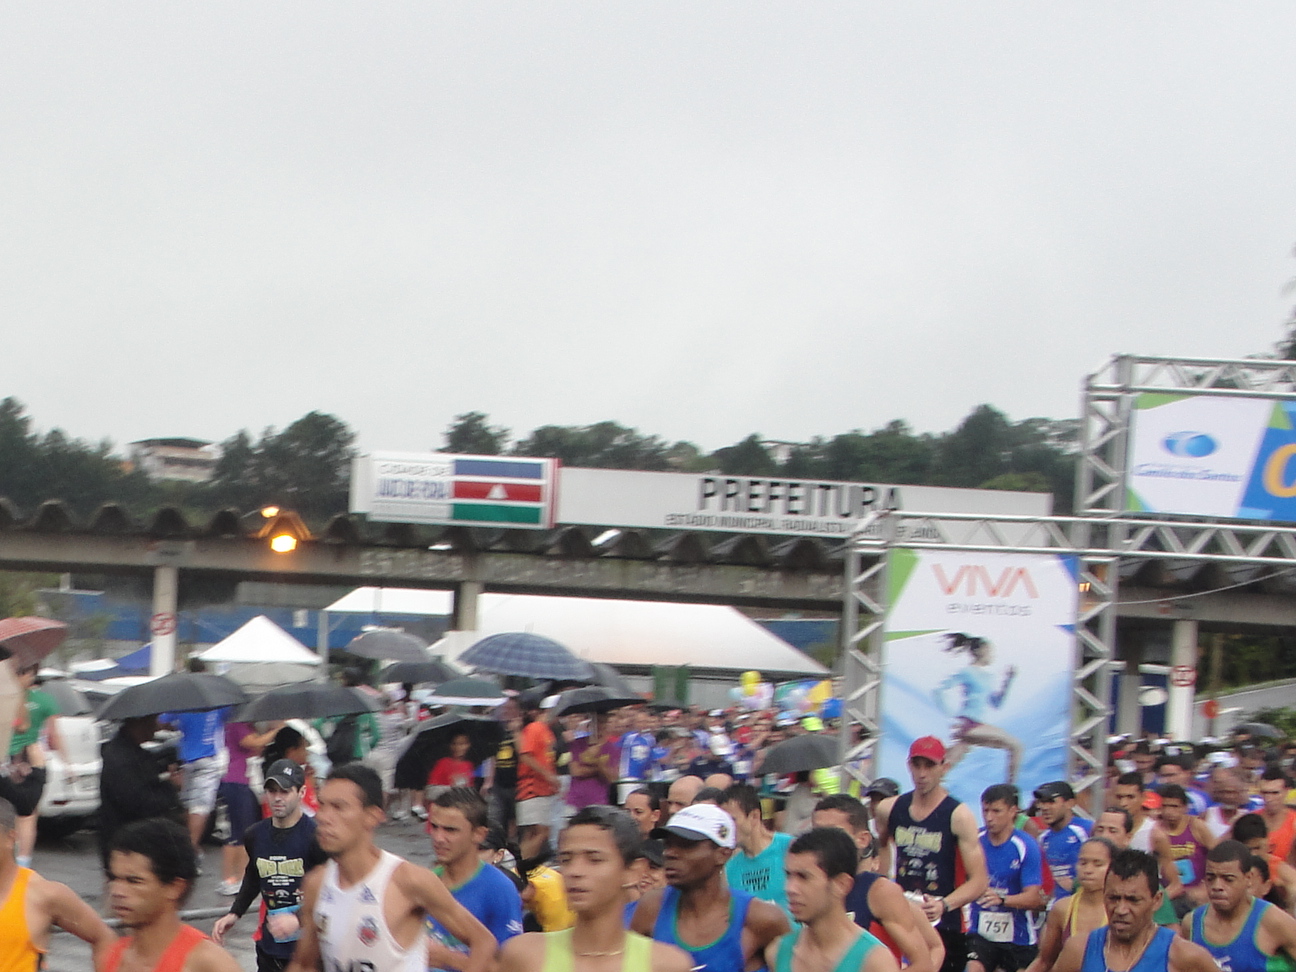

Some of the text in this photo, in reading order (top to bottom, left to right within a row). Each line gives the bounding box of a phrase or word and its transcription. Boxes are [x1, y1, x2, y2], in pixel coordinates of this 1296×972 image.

[699, 477, 903, 519] PREFEITURA
[931, 563, 1040, 599] VIVA
[984, 919, 1010, 934] 757
